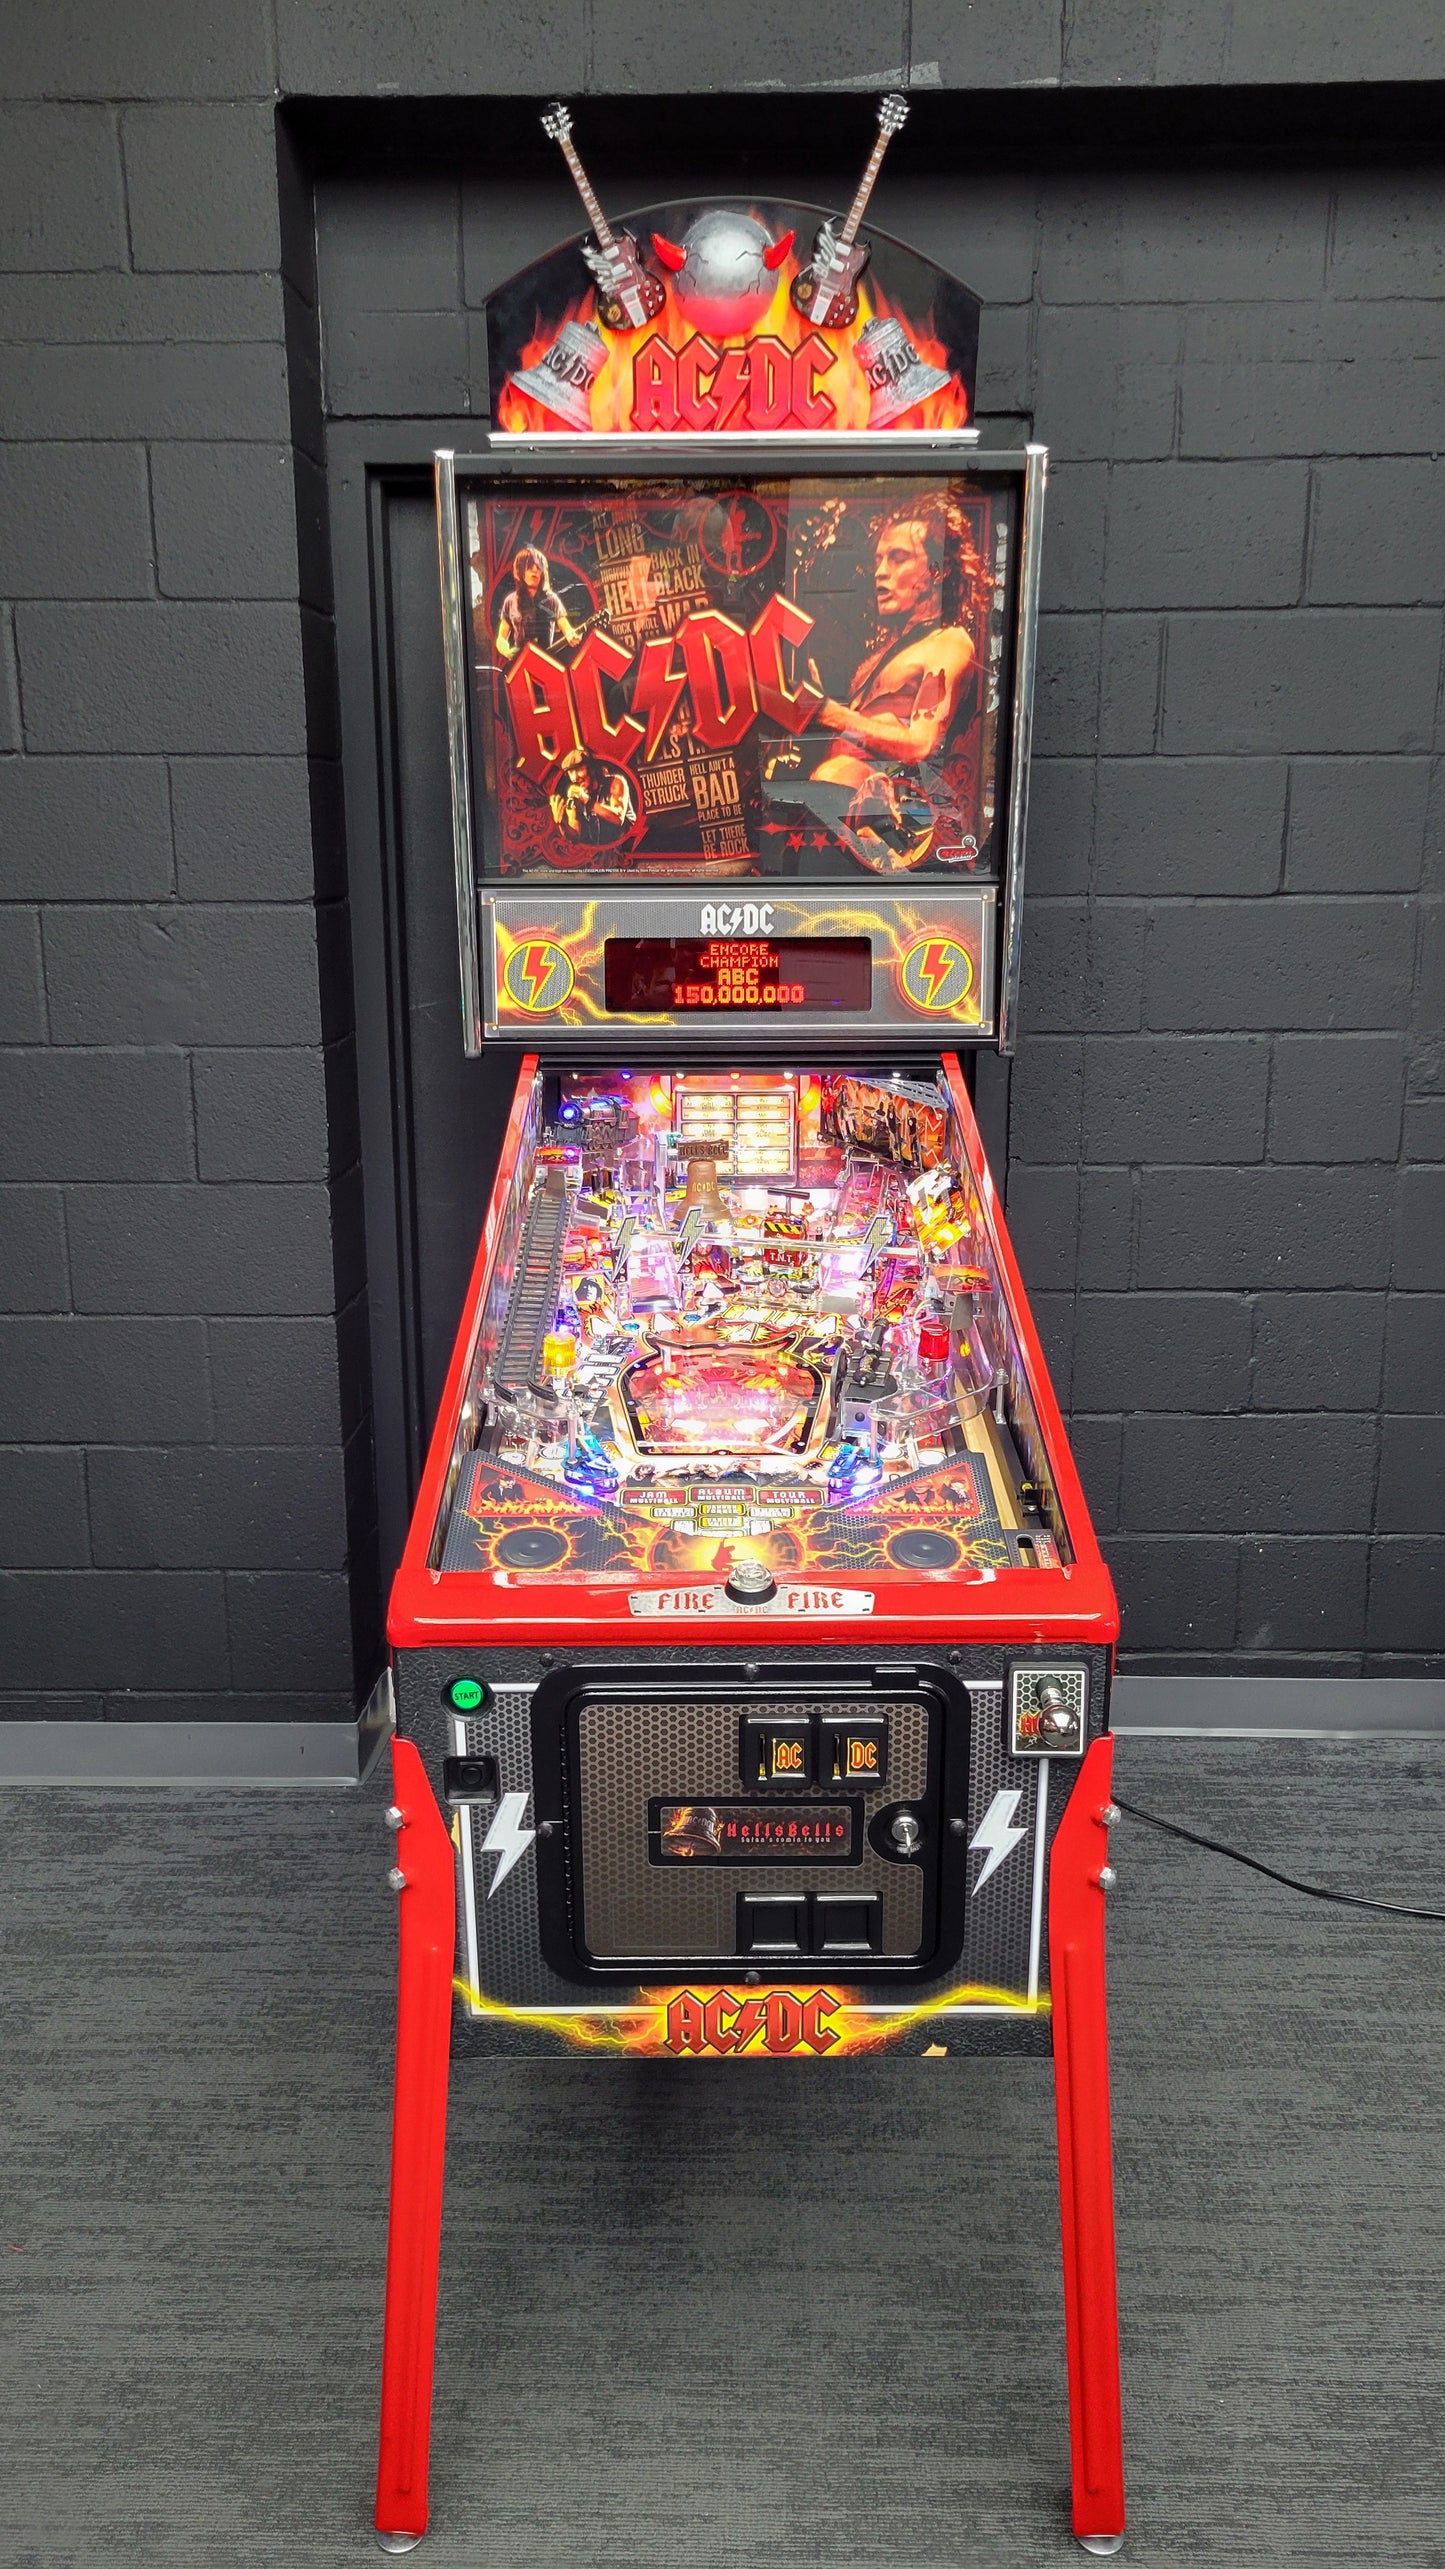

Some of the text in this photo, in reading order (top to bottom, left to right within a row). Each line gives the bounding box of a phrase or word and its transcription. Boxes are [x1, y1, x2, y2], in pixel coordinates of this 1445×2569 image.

[630, 332, 838, 431] AC/DC
[651, 544, 700, 571] BACK IN
[654, 565, 706, 596] BLACK
[603, 575, 657, 619] HELL
[503, 592, 824, 781] AC/DC
[690, 762, 707, 776] HELL
[728, 757, 735, 769] A
[640, 767, 686, 789] THUNDER
[644, 782, 689, 807] STRUCK
[692, 770, 740, 810] BAD
[698, 805, 744, 822] PLACE TO BE
[701, 824, 746, 843] LET THERE
[703, 837, 750, 860] BE ROCK
[700, 903, 775, 936] AC/DC
[709, 943, 769, 955] ENCORE
[700, 955, 779, 968] CHAMPION
[717, 968, 759, 985] ABC
[674, 985, 805, 1005] 150,000,000
[698, 1488, 745, 1496] ALBUM
[657, 1591, 715, 1610] FIRE
[787, 1591, 844, 1609] FIRE
[454, 1691, 479, 1701] START
[776, 1742, 803, 1769] AC
[850, 1741, 877, 1768] DC
[665, 1988, 843, 2056] AC/DC
